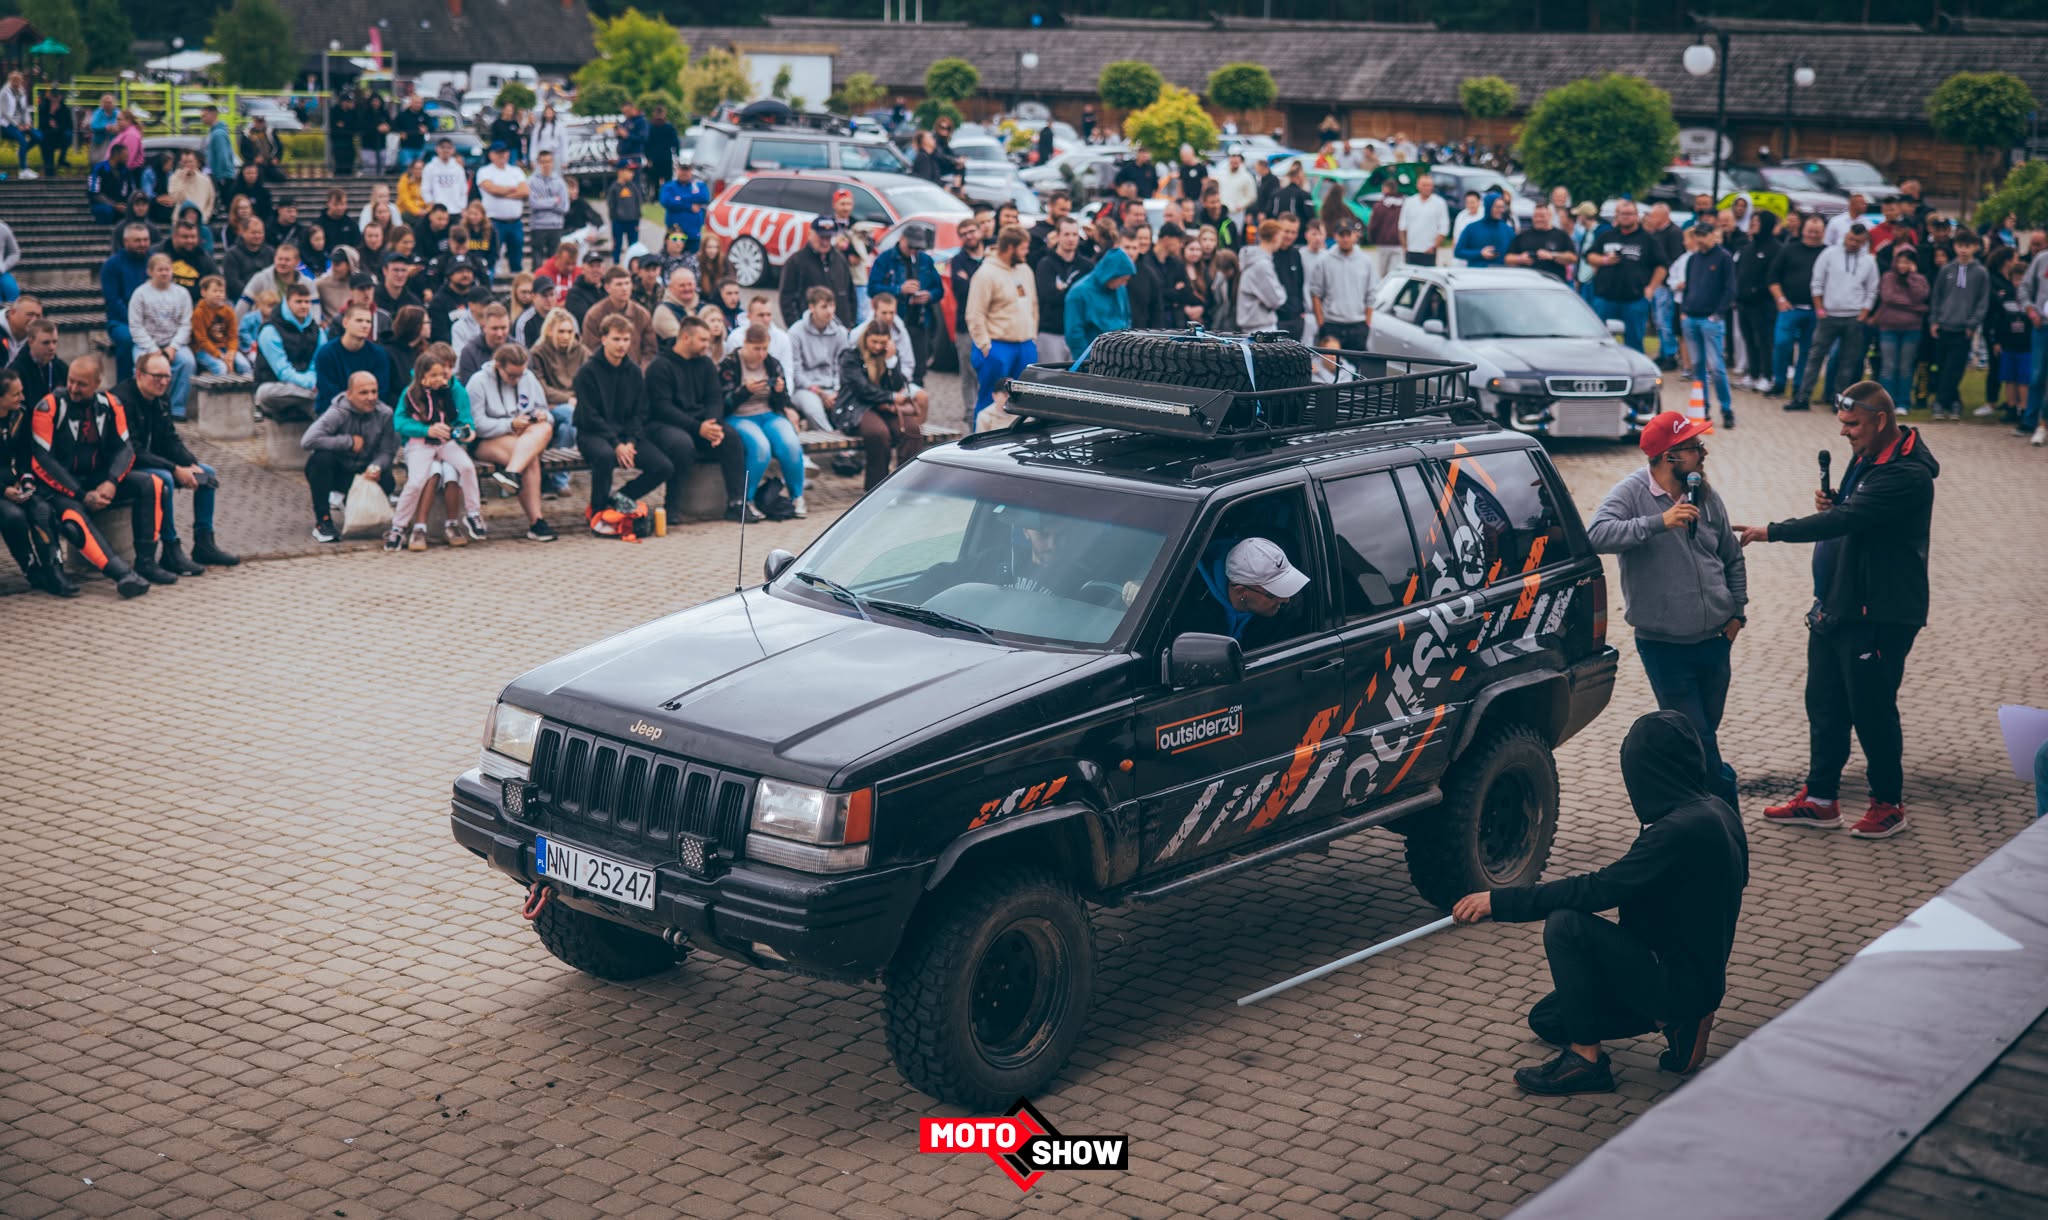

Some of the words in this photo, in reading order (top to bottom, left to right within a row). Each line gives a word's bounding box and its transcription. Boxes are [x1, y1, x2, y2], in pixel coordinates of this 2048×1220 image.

[630, 719, 663, 741] Jeep
[1160, 713, 1239, 750] outsiderzy
[537, 858, 545, 868] PL
[547, 843, 578, 882] NNI
[587, 858, 651, 902] 25247
